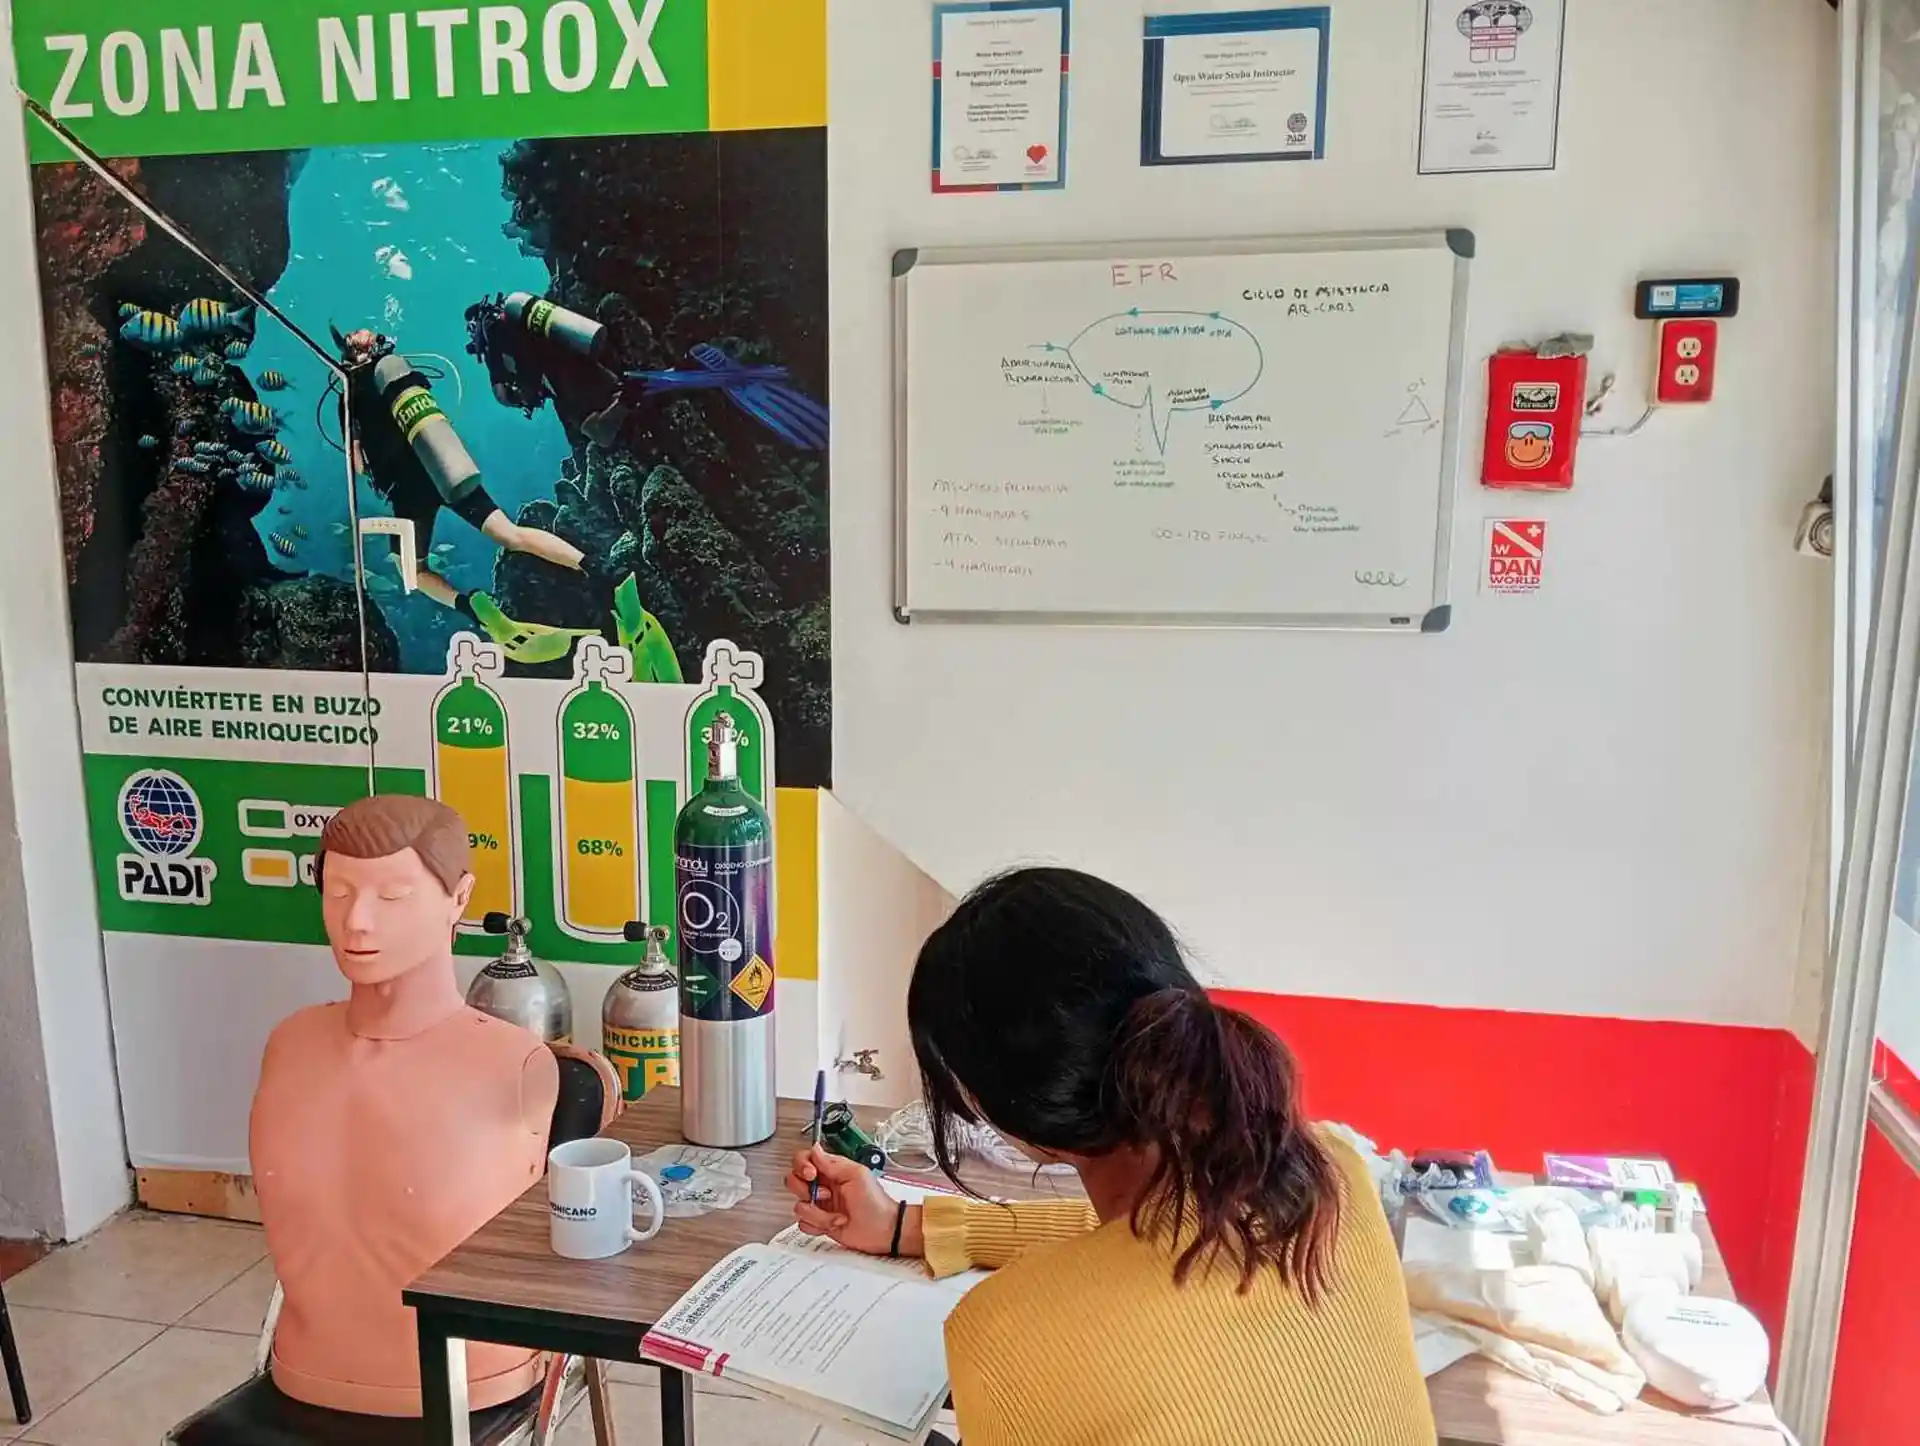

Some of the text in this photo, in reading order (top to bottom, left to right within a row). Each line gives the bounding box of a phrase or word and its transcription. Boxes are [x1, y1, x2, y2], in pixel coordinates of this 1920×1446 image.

[44, 0, 668, 119] ZONA NITROX
[1173, 68, 1297, 85] Open Water Scuba Instructor
[1111, 262, 1178, 287] EFR
[1242, 288, 1285, 301] CICLO
[1294, 287, 1309, 300] DE
[1494, 544, 1511, 555] W
[1490, 559, 1541, 576] DAN
[1491, 576, 1541, 585] WORLD
[102, 685, 381, 717] CONVIÉRTETE EN BUZO
[109, 715, 379, 745] DE AIRE ENRIQUECIDO
[447, 716, 493, 736] 21%
[573, 721, 620, 741] 32%
[701, 726, 749, 747] 3%
[294, 812, 330, 829] OXY
[467, 832, 498, 851] 9%
[577, 837, 623, 857] 68%
[123, 860, 206, 898] PADI
[683, 891, 730, 932] O2
